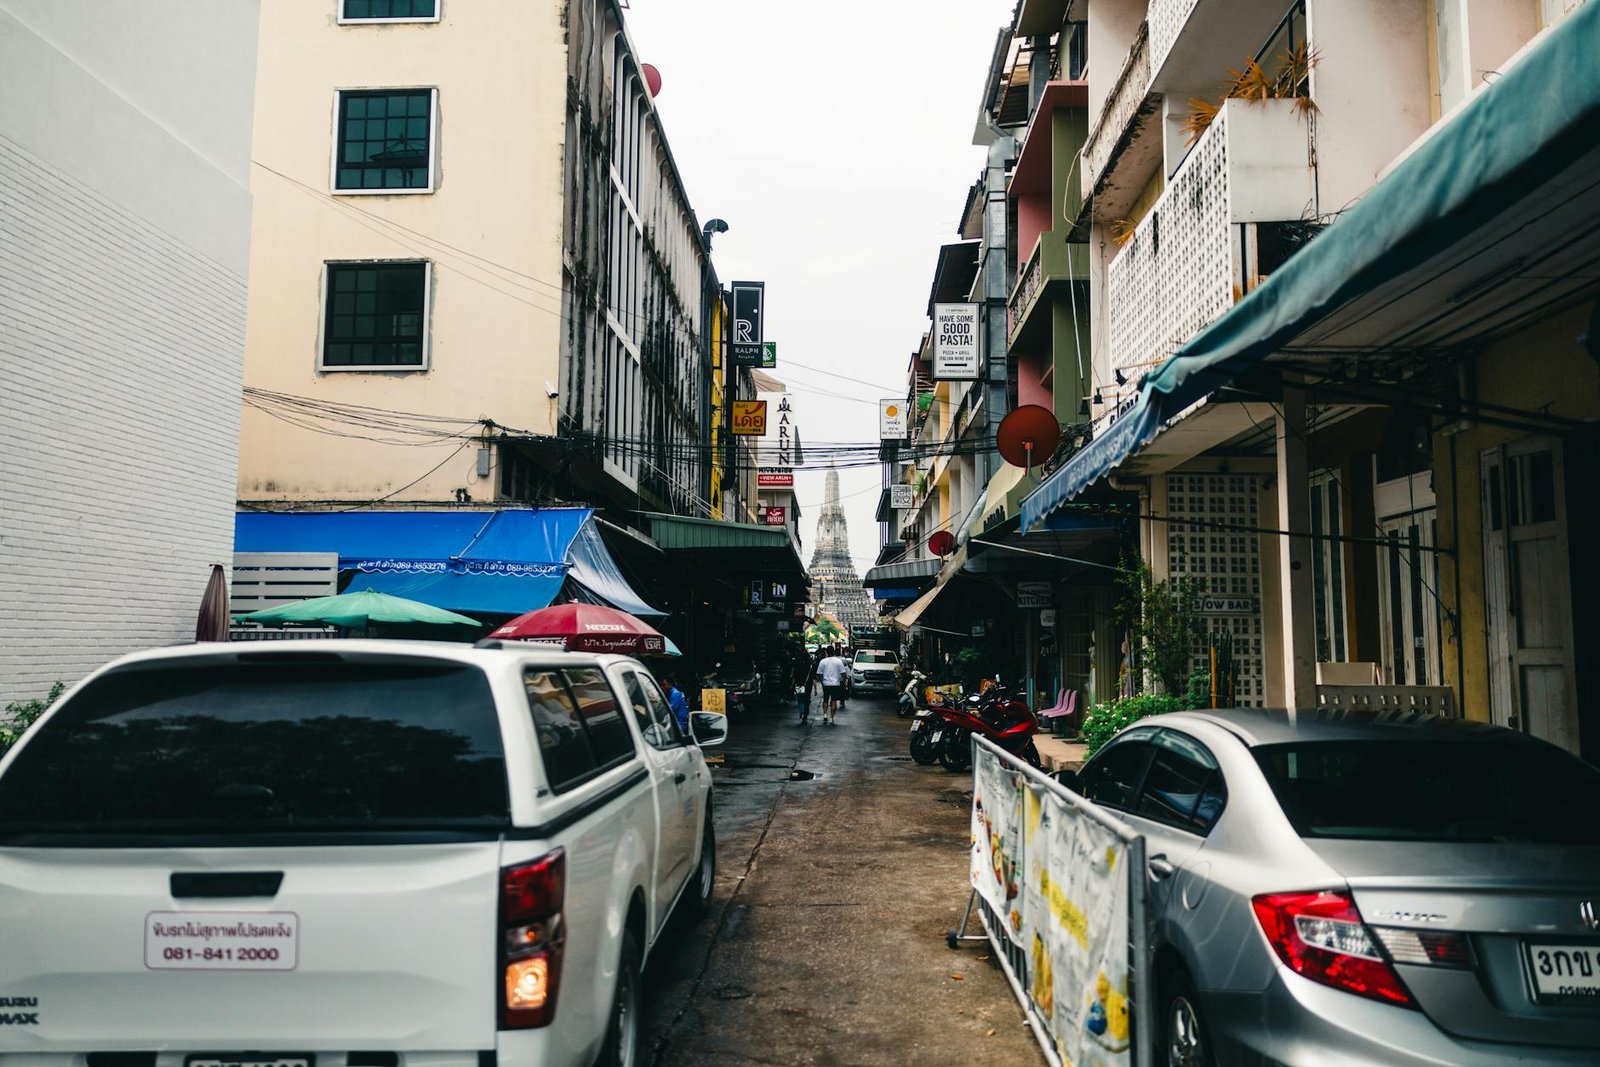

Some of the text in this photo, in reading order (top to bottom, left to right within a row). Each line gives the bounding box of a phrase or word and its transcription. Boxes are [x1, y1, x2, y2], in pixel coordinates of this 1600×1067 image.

[939, 315, 974, 323] HAVE SOME
[943, 323, 970, 334] GOOD
[940, 335, 973, 346] PASTA!
[778, 413, 791, 466] ARUN
[1227, 600, 1251, 610] BAR
[163, 947, 280, 961] 081-841 2000
